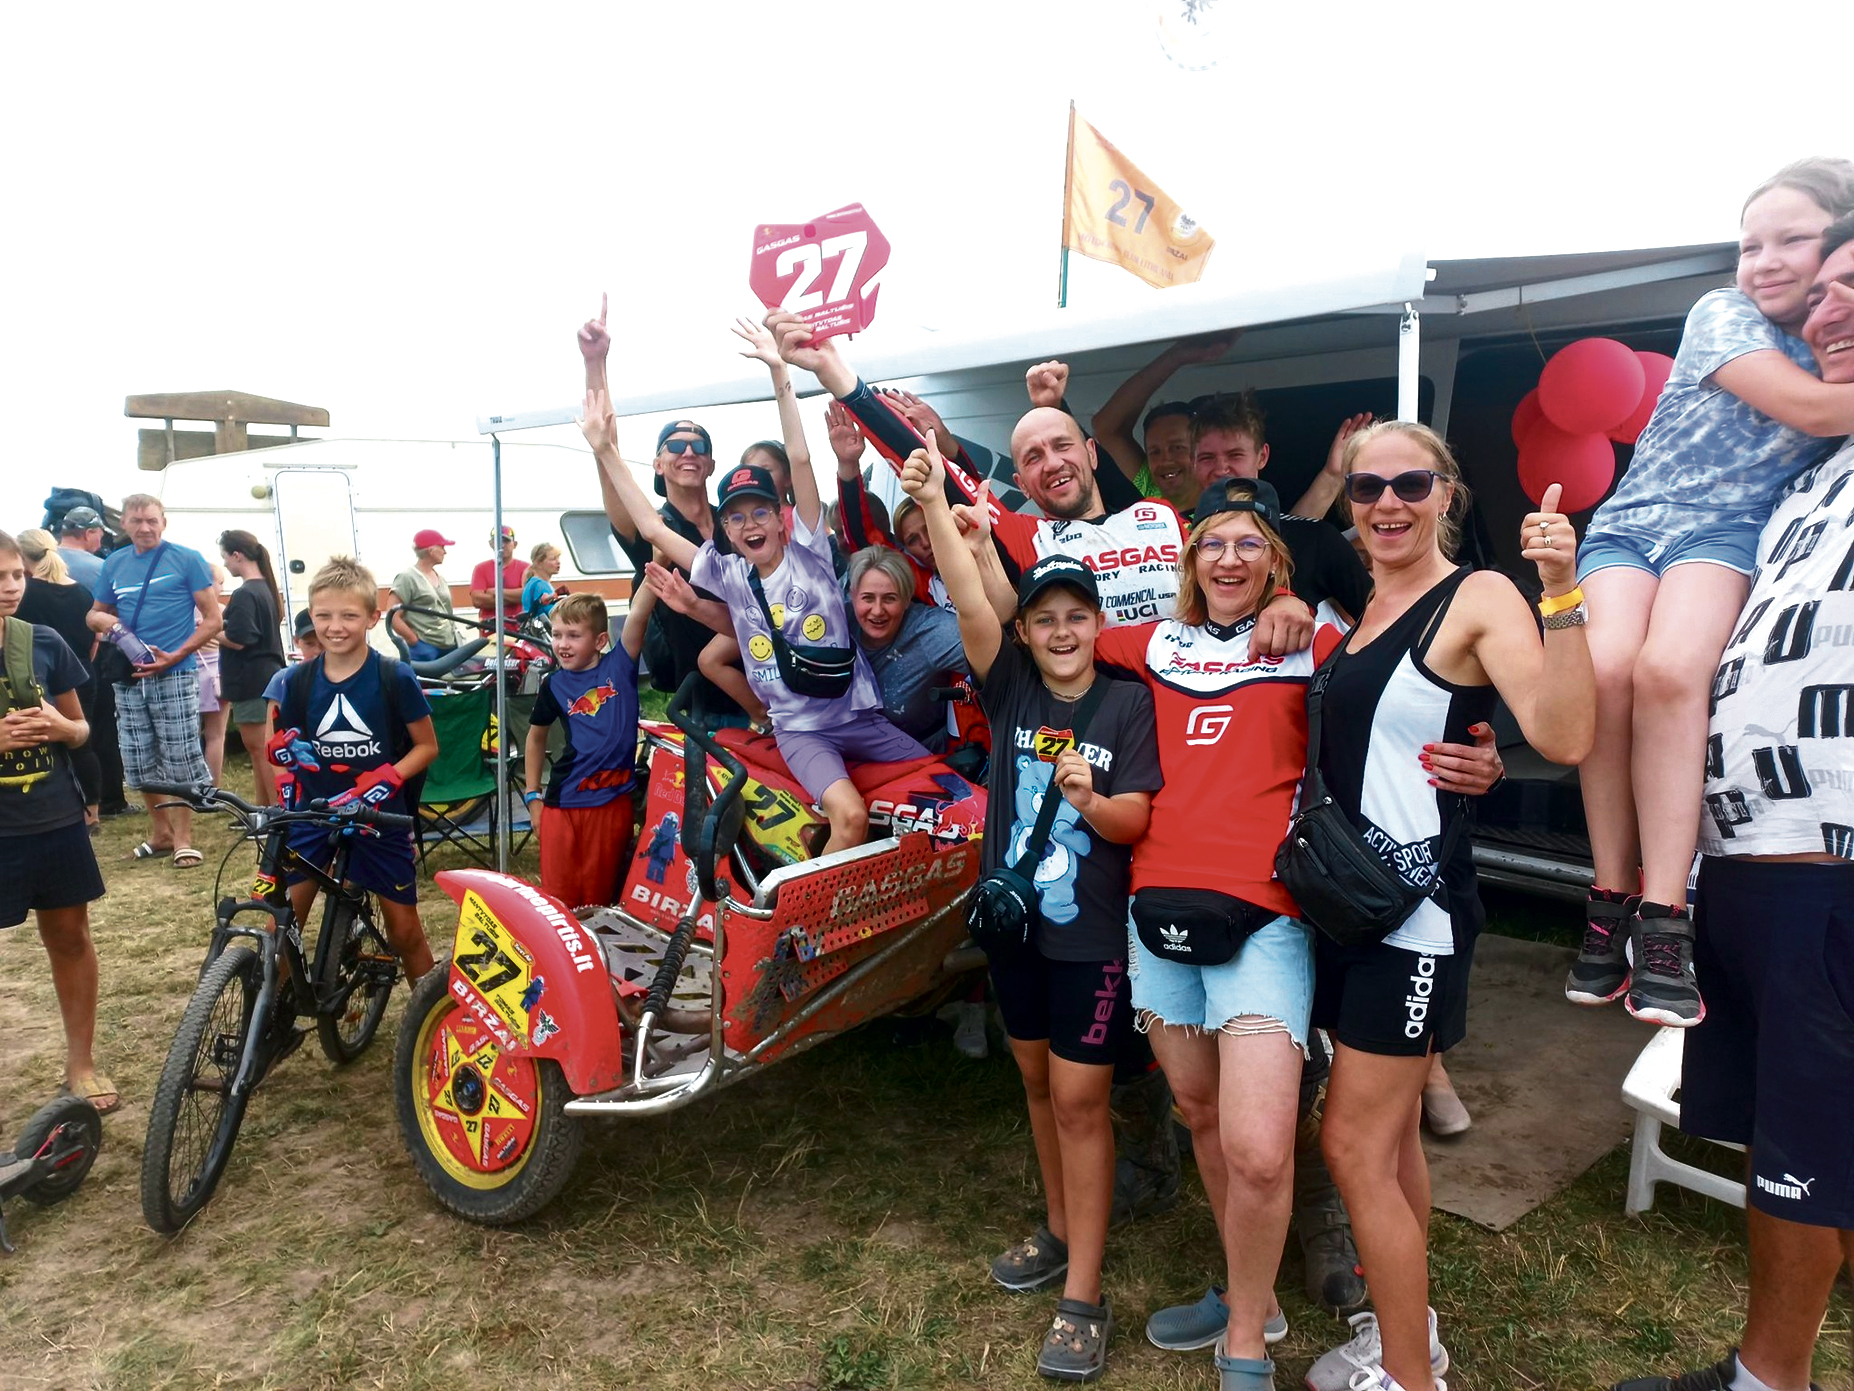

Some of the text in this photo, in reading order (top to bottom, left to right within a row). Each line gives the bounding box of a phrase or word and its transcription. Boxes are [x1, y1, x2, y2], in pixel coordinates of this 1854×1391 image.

[1104, 179, 1155, 235] 27
[757, 234, 801, 255] GASGAS
[776, 230, 868, 315] 27
[1081, 544, 1181, 573] ASGAS
[1124, 603, 1159, 621] UCI
[752, 669, 782, 684] SMIL
[1038, 736, 1070, 757] 27
[744, 784, 797, 831] 27
[253, 878, 274, 894] 27
[1163, 943, 1192, 952] adidas
[455, 930, 522, 993] 27
[1404, 952, 1436, 1039] adida
[465, 1120, 478, 1133] 27
[1756, 1174, 1802, 1200] PUMA
